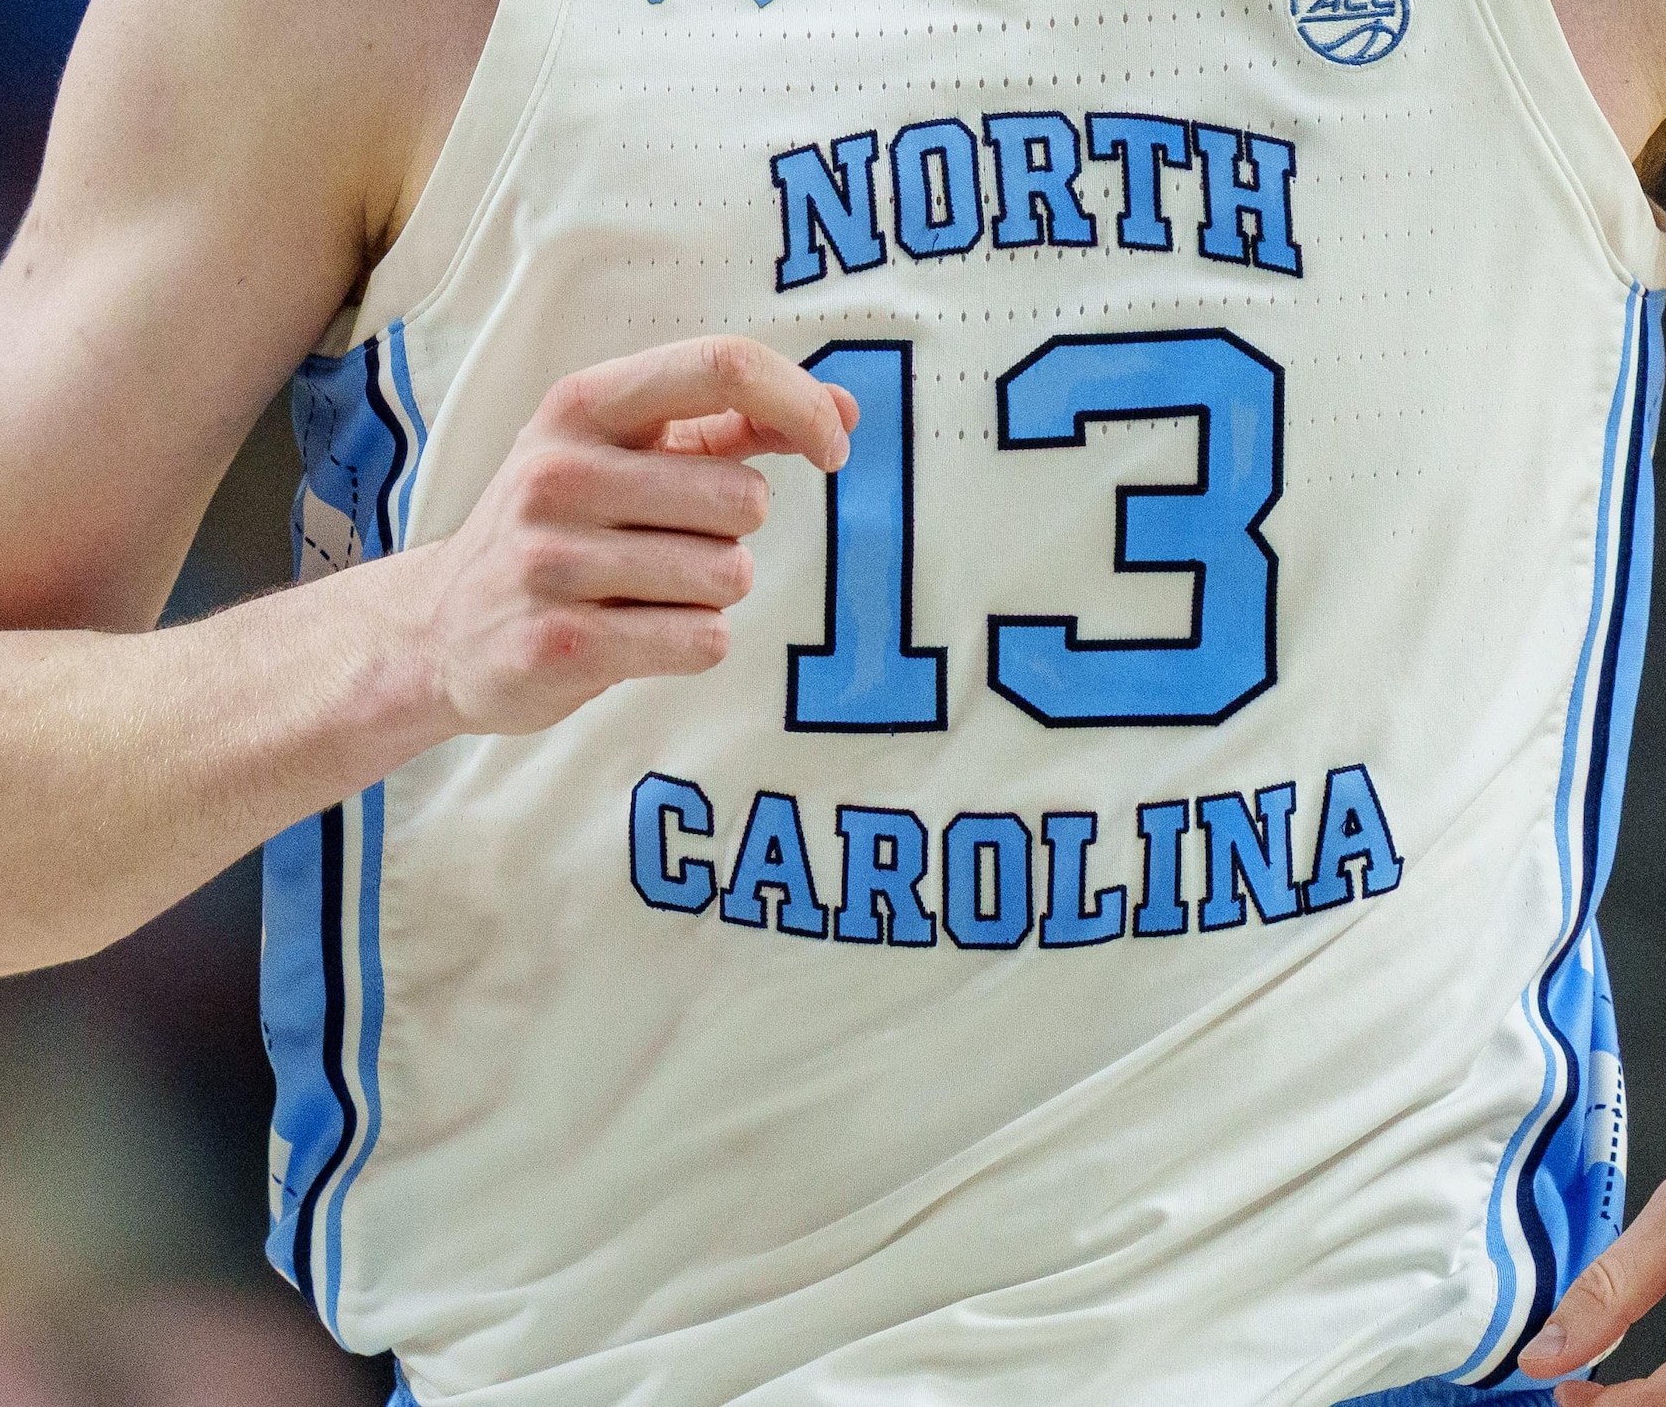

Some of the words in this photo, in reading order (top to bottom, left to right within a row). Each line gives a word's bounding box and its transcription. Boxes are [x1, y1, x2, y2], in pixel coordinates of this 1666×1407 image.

[770, 111, 1303, 294] NORTH
[785, 329, 1286, 733] 13
[630, 764, 1403, 950] CAROLINA
